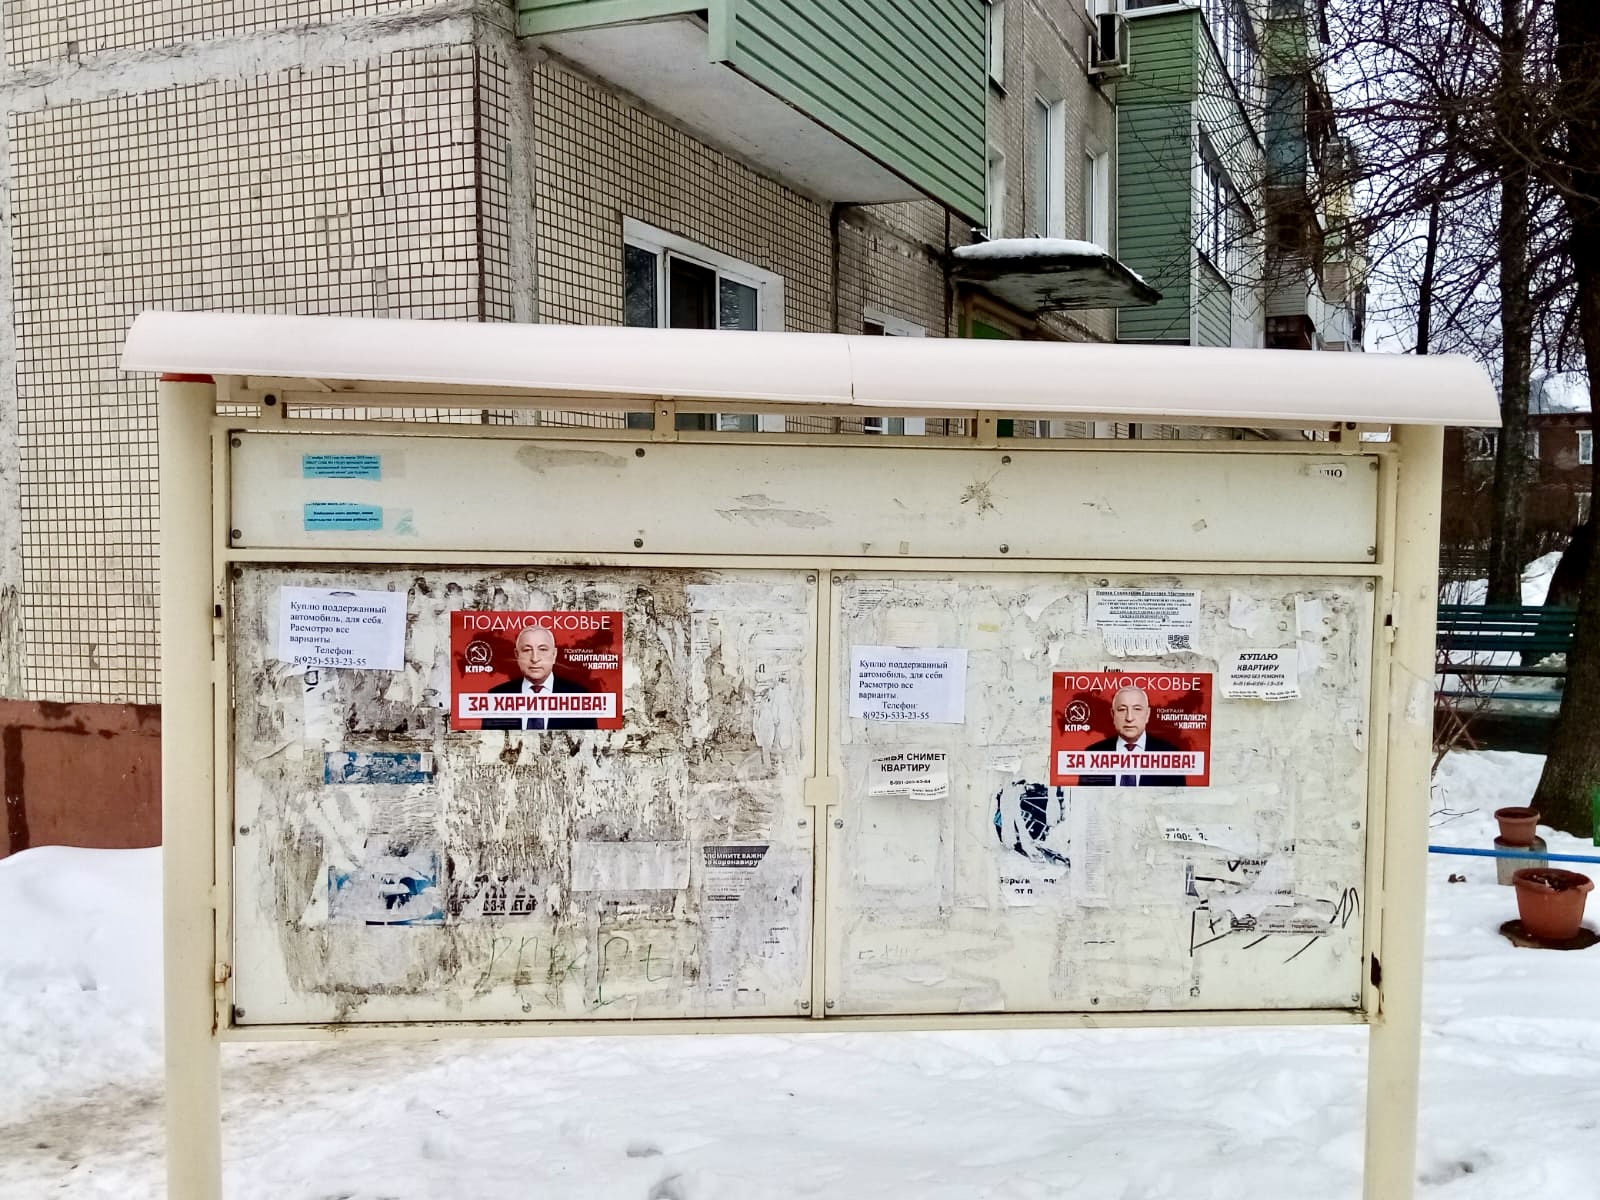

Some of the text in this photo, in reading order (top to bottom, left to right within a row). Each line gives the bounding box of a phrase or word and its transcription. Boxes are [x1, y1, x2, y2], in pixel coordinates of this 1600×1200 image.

[291, 601, 387, 614] Куплю поддержанный
[290, 614, 342, 624] автомобиль,
[463, 615, 610, 632] ПОДМОСКОВЬЕ
[290, 623, 333, 634] Расмотрю
[294, 656, 367, 666] 8(925)-533-23-55
[569, 654, 618, 662] КАПИТАЛИЗМ
[1239, 653, 1278, 661] КУПЛЮ
[465, 665, 493, 673] КПРФ
[588, 662, 618, 670] ХВАТИТ!
[859, 660, 948, 670] Куплю поддержанный
[859, 671, 907, 679] автомобиль,
[1065, 676, 1201, 691] ПОДМОСКОВЬЕ
[468, 696, 607, 711] ЗА ХАРИТОНОВА!
[862, 711, 930, 720] 8(925)-533-23-55
[1064, 724, 1091, 732] КПРФ
[906, 753, 947, 761] СНИМЕТ
[1066, 754, 1196, 768] ЗА ХАРИТОНОВА!
[881, 763, 931, 772] КВАРТИРУ
